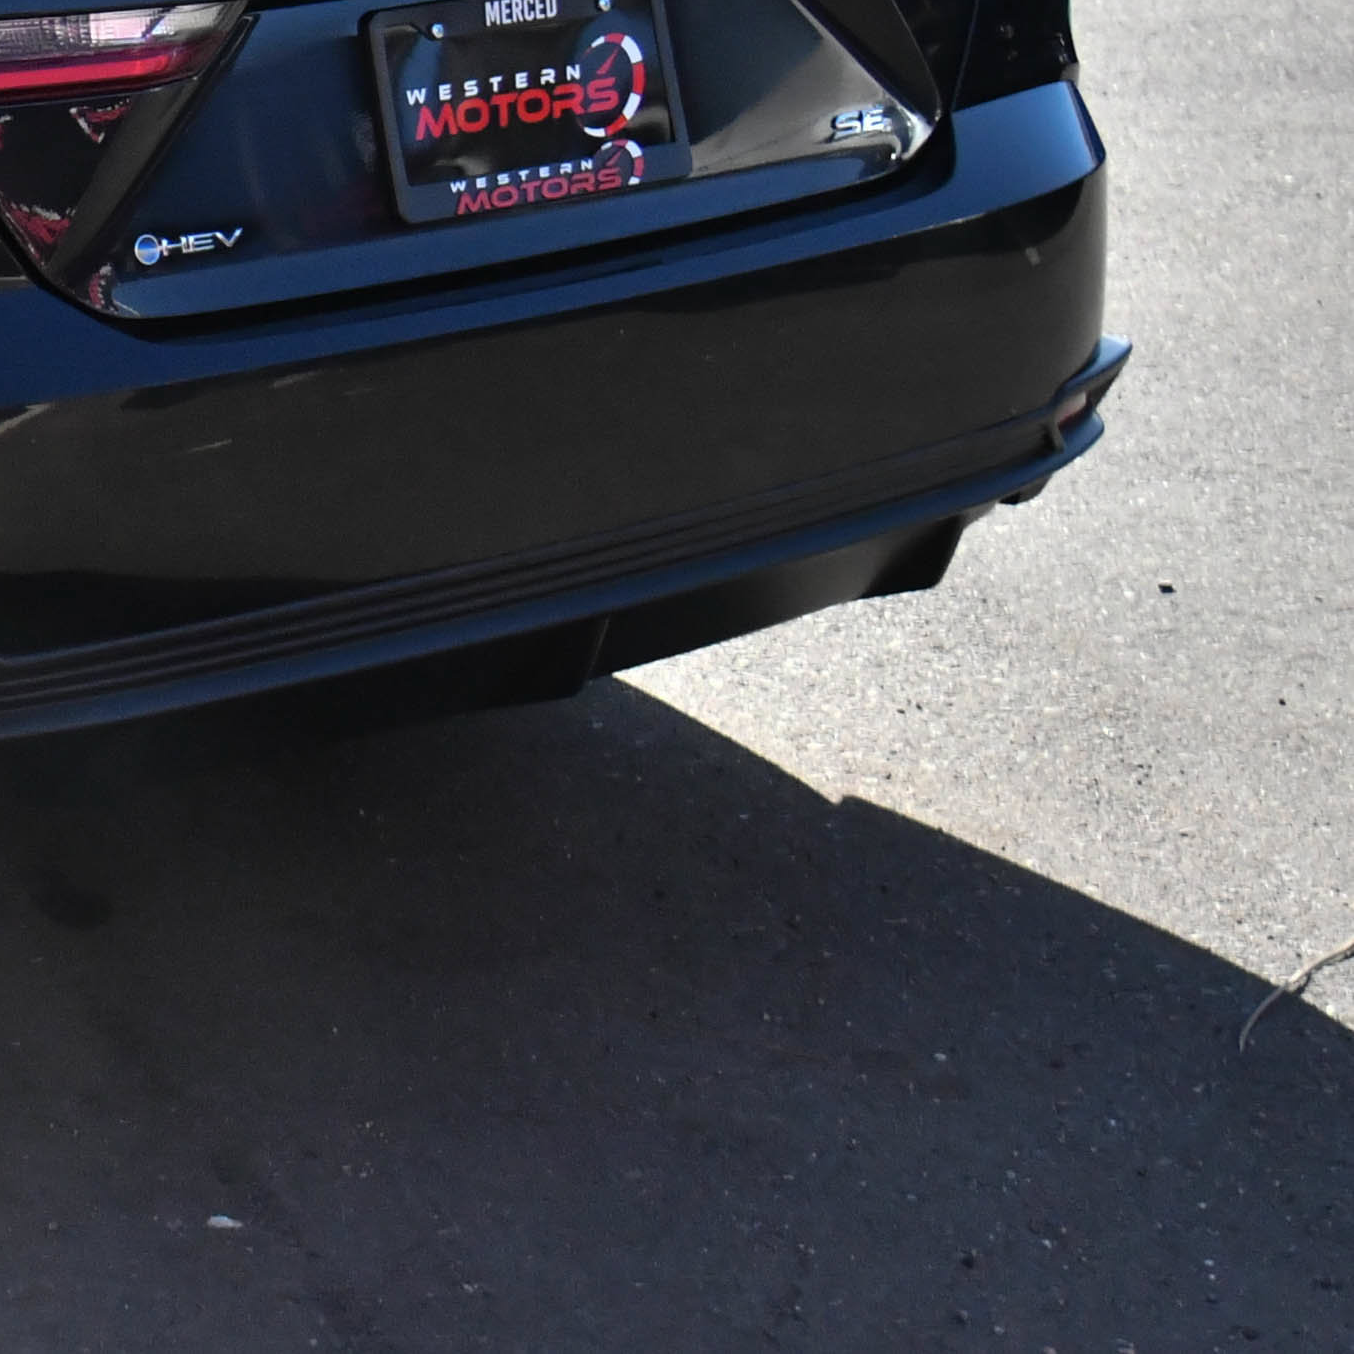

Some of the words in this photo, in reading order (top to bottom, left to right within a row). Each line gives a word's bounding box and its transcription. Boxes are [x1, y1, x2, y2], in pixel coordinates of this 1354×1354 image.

[406, 63, 581, 106] WESTERN
[415, 77, 620, 141] MOTORS
[832, 106, 886, 140] SE
[450, 158, 594, 194] WESTERN
[456, 168, 623, 216] MOTORS
[161, 227, 243, 256] HEV
